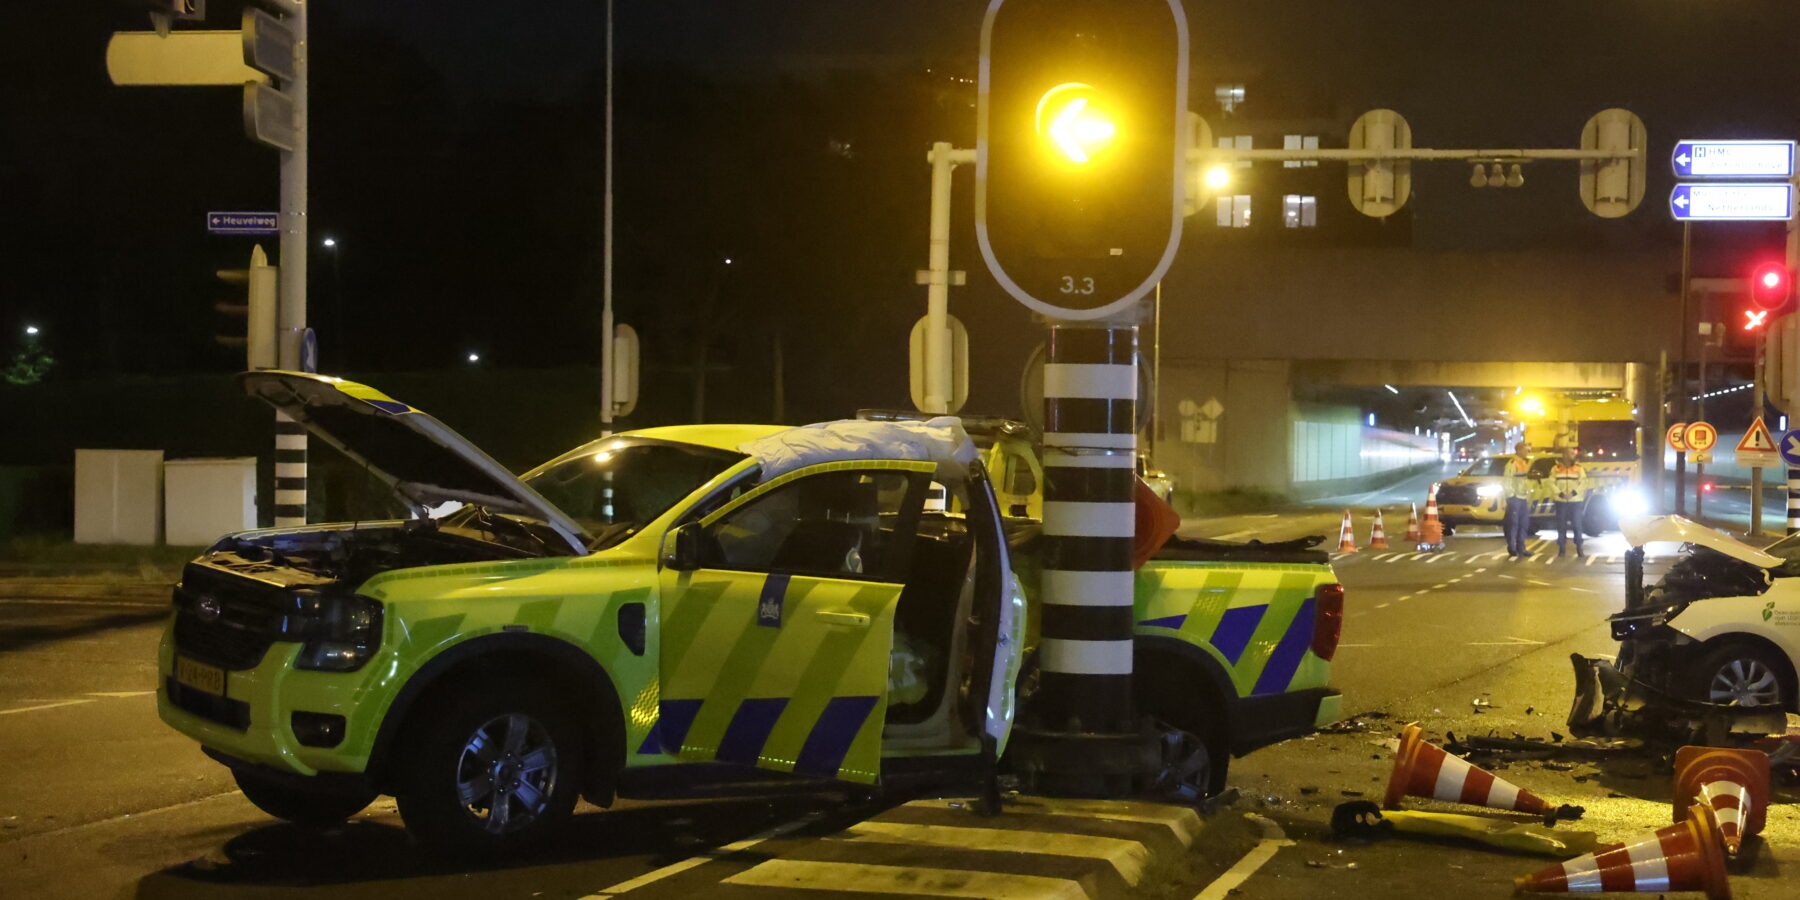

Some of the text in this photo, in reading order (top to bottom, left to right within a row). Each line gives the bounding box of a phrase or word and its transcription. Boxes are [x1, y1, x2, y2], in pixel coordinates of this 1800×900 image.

[223, 216, 276, 227] Heuvelweg
[1060, 275, 1095, 295] 3.3
[1697, 454, 1704, 463] C
